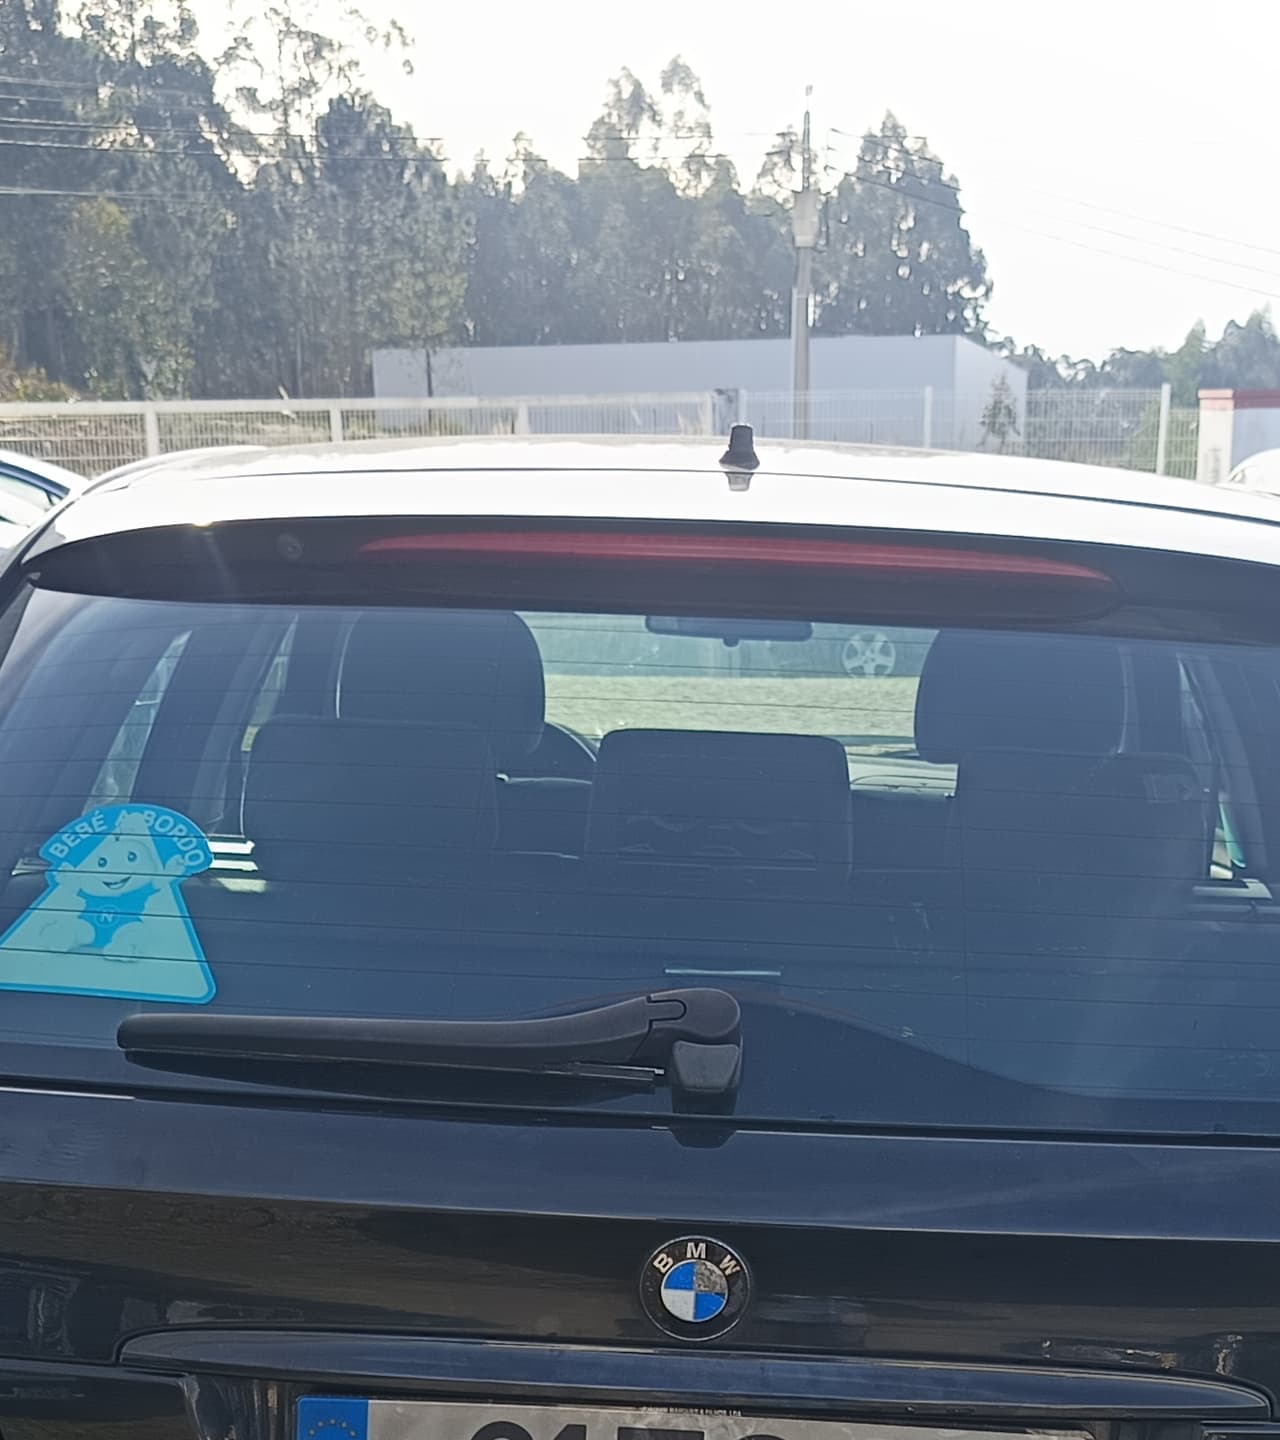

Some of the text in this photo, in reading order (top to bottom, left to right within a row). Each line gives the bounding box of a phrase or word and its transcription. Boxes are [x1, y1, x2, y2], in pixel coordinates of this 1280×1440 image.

[48, 809, 109, 859] BEBÉ
[142, 809, 205, 867] BORDO
[652, 1241, 741, 1276] BMW
